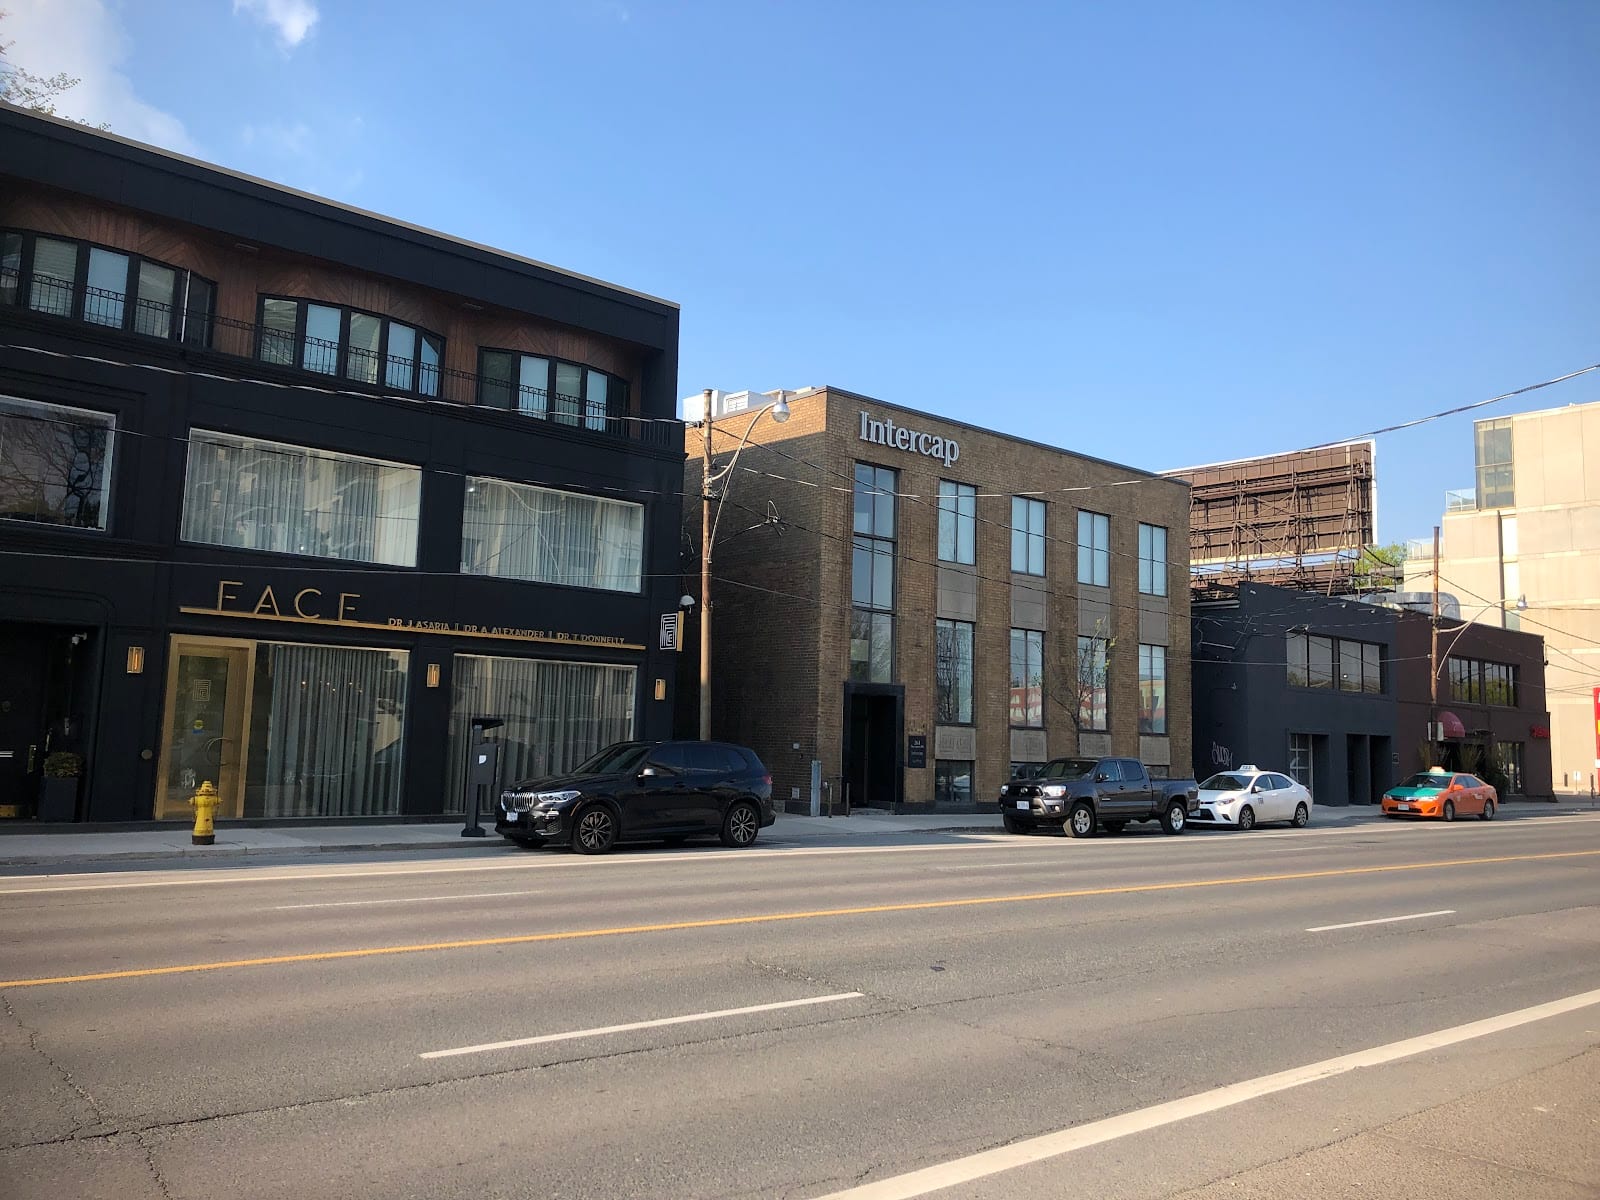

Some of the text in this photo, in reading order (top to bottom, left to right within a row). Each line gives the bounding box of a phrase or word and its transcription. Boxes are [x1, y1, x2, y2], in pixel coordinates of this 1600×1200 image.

[860, 411, 960, 468] Intercap
[216, 580, 361, 622] FACE
[416, 620, 450, 631] ASARIA
[491, 627, 545, 639] ALEXANDER
[581, 634, 625, 645] DONNELLY
